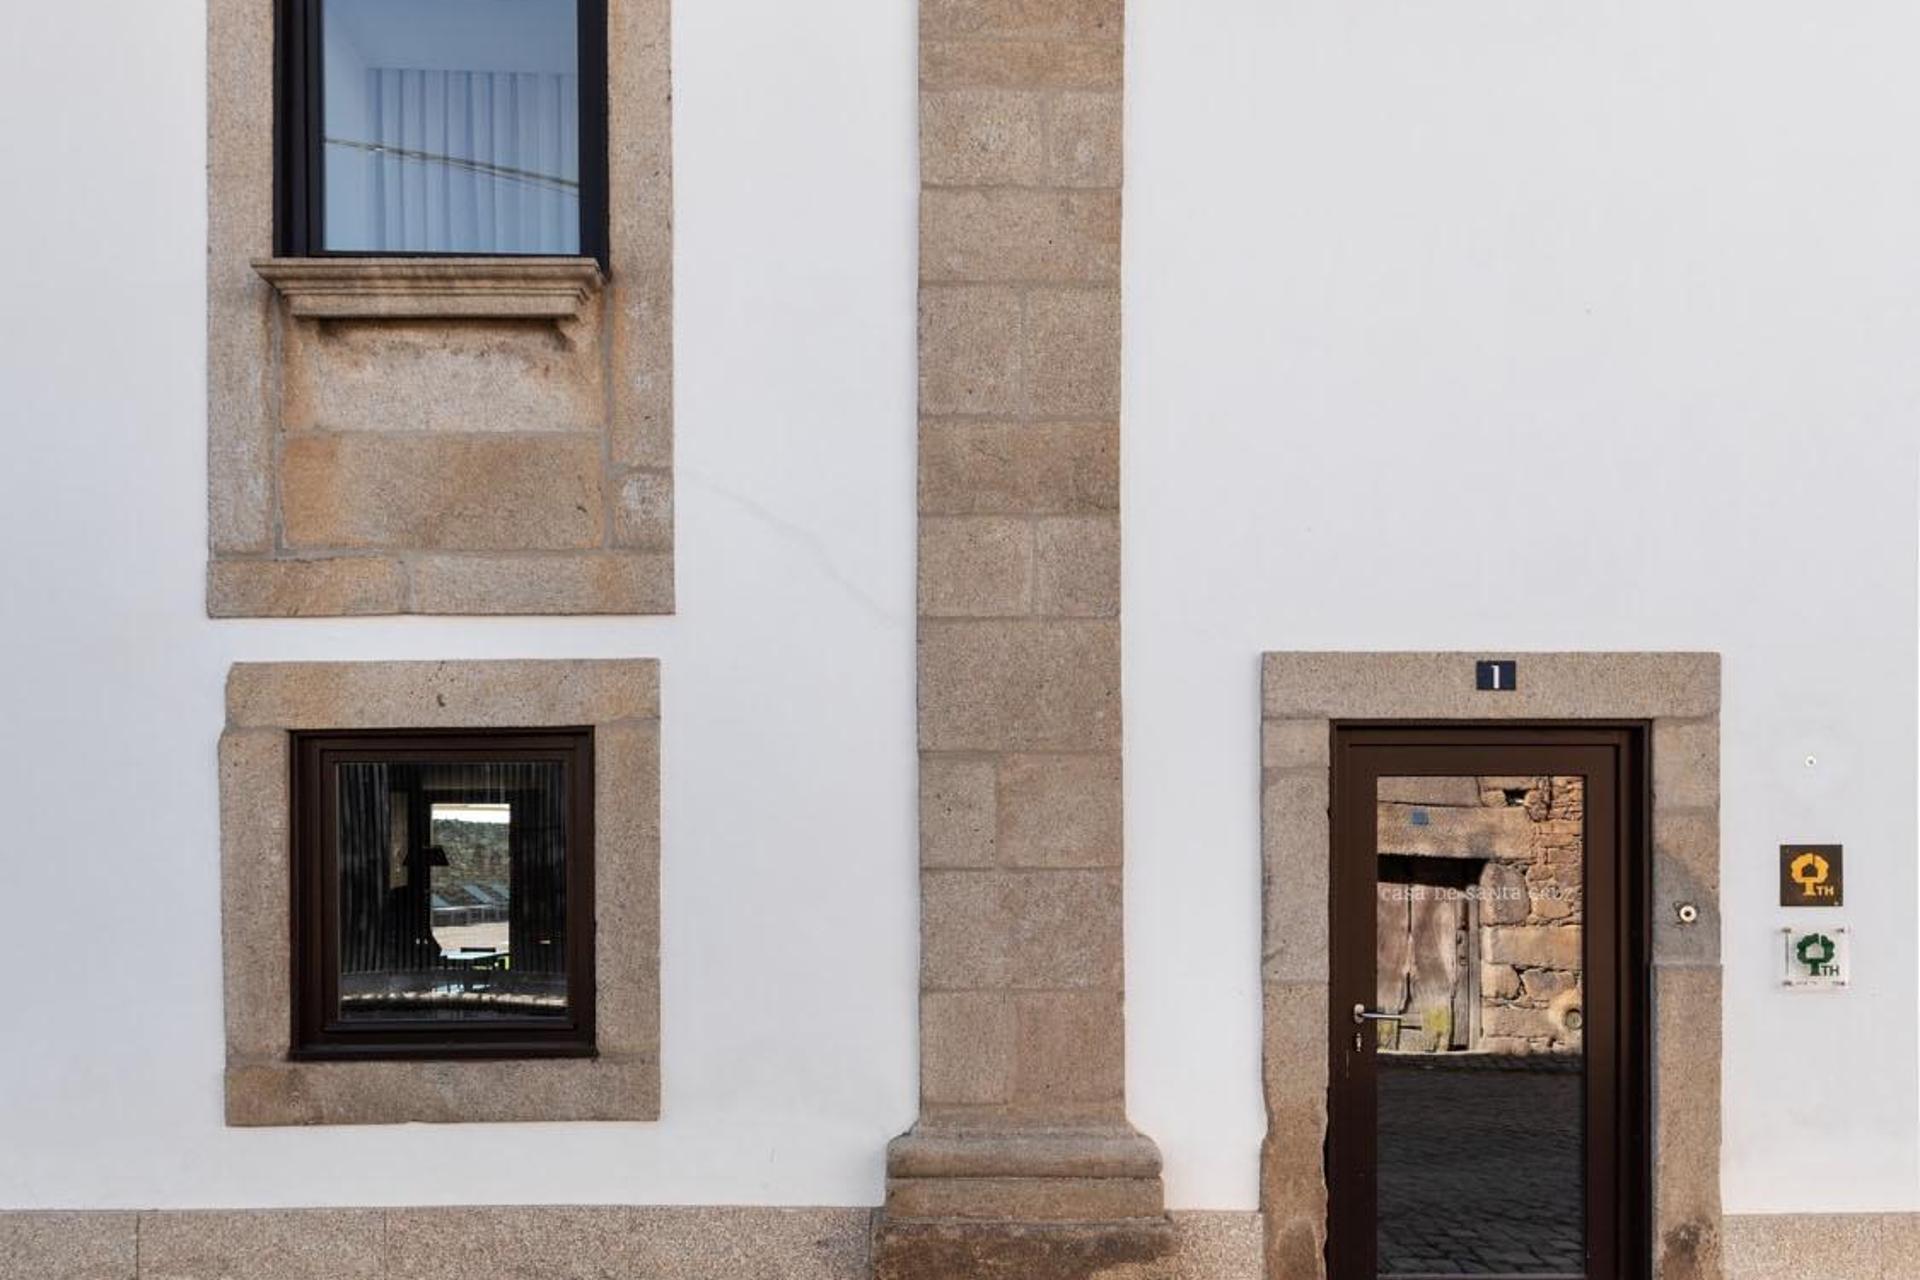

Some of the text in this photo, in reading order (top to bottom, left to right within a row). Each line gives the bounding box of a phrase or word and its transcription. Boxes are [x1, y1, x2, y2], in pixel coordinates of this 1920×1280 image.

[1491, 665, 1500, 689] 1
[1816, 885, 1834, 896] TH
[1821, 965, 1840, 976] TH
